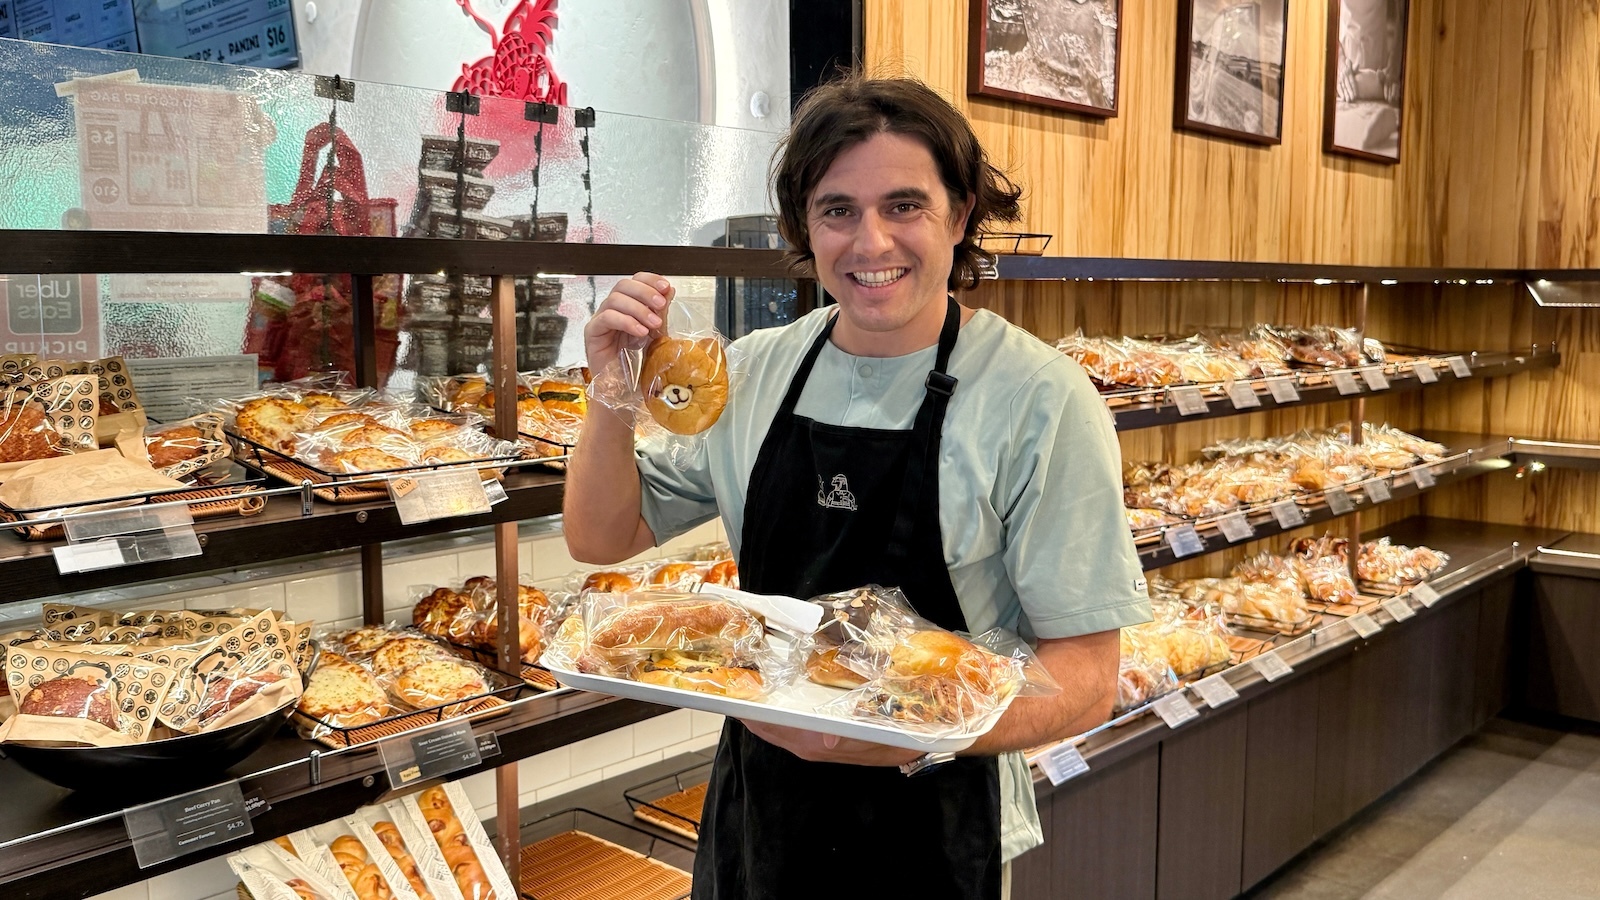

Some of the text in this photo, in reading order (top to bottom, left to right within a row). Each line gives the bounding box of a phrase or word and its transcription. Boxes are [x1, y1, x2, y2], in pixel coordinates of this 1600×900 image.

[228, 35, 260, 56] PANINI
[267, 25, 286, 48] $16
[396, 479, 412, 491] NEW
[184, 804, 197, 813] Beef
[197, 801, 211, 811] Curry
[211, 798, 221, 807] Pan
[227, 821, 245, 831] $4.75
